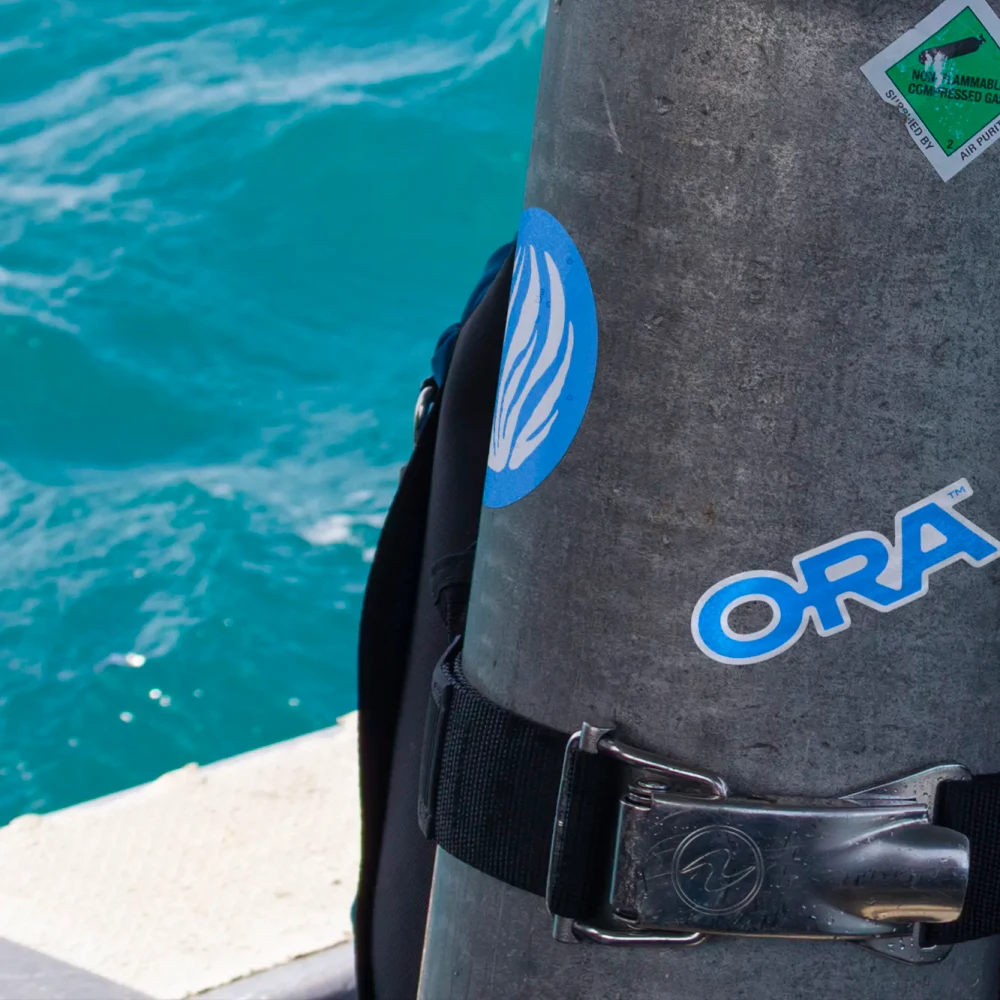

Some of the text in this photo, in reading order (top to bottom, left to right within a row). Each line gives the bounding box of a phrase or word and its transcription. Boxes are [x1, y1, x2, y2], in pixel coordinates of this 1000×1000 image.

[919, 134, 935, 151] BY
[946, 139, 954, 149] 2
[960, 143, 977, 161] AIR
[698, 502, 999, 659] ORA
